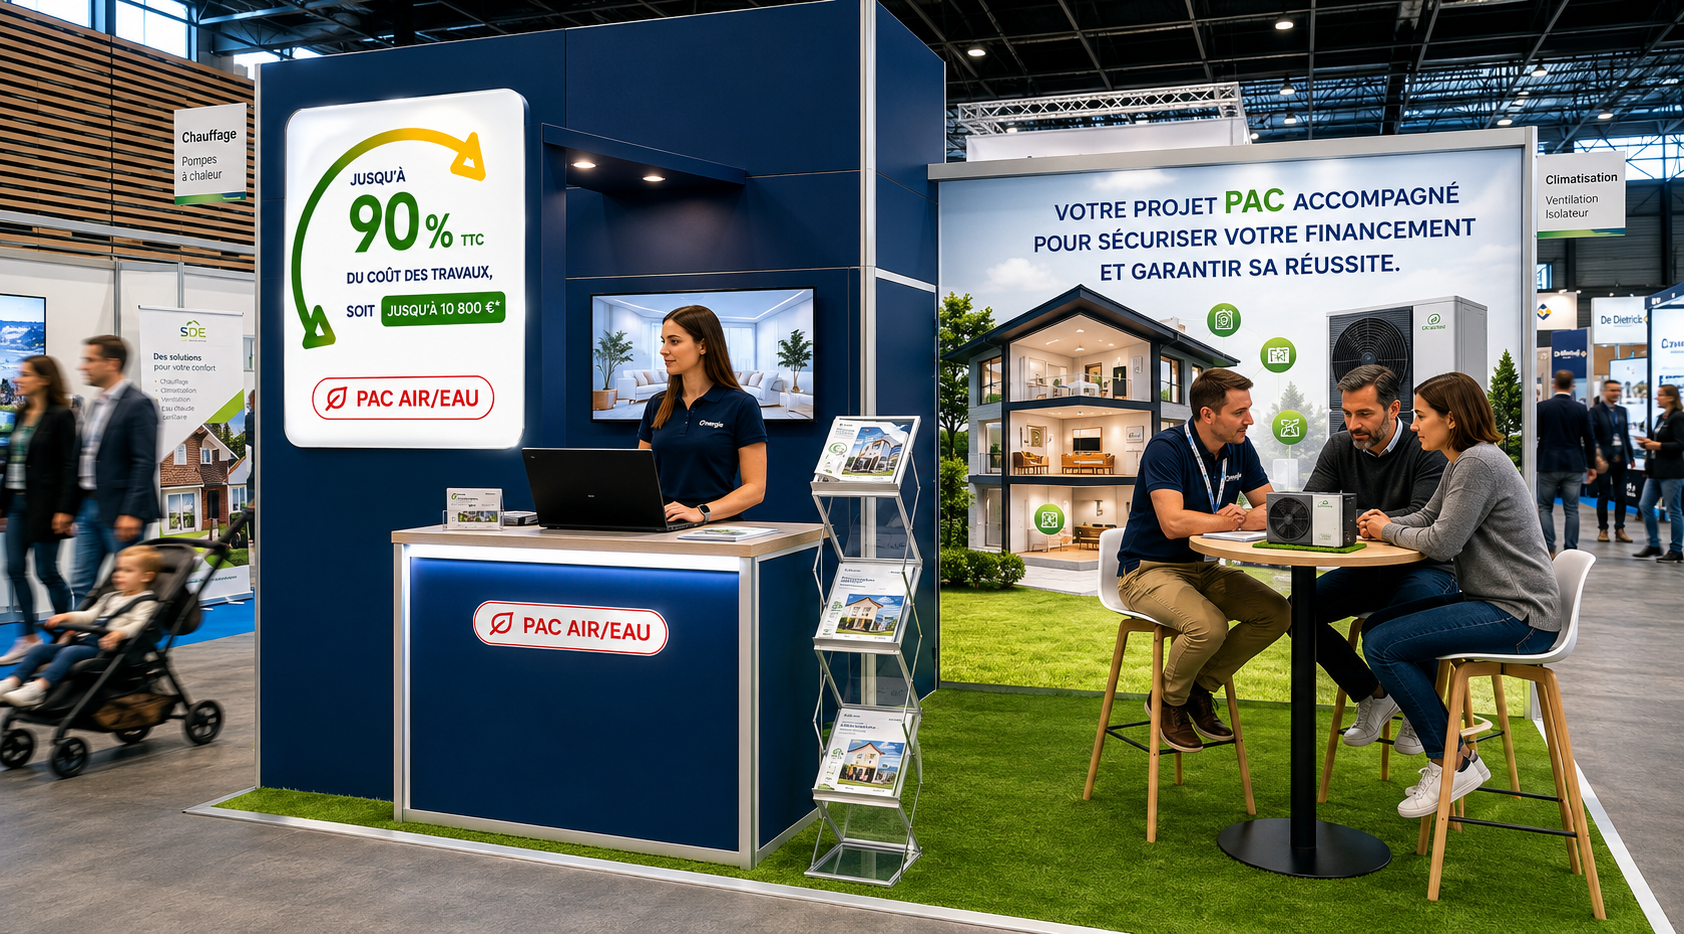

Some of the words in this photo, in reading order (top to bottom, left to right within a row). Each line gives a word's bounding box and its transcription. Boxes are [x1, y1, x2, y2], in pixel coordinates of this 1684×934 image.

[181, 129, 237, 143] Chauffage
[181, 155, 218, 167] Pompes
[181, 171, 188, 182] à
[189, 170, 223, 182] chaleur
[350, 166, 406, 186] JUSQU'À
[1545, 172, 1618, 185] Climatisation
[1054, 201, 1127, 221] VOTRE
[1134, 196, 1218, 218] PROJET
[1225, 187, 1285, 214] PAC
[1292, 181, 1460, 211] ACCOMPAGNÉ
[1545, 194, 1599, 205] Ventilation
[1545, 208, 1589, 219] Isolateur
[349, 191, 420, 254] 90
[425, 212, 454, 249] %
[460, 232, 485, 247] TTC
[1034, 234, 1092, 253] POUR
[1098, 229, 1218, 251] SÉCURISER
[1223, 225, 1298, 246] VOTRE
[1305, 217, 1477, 242] FINANCEMENT
[1100, 264, 1126, 282] ET
[1131, 260, 1242, 281] GARANTIR
[1248, 258, 1279, 277] SA
[1285, 252, 1401, 275] RÉUSSITE.
[346, 272, 364, 285] DU
[367, 266, 402, 284] COÛT
[404, 268, 429, 282] DES
[431, 265, 493, 281] TRAVAUX,
[346, 304, 376, 318] SOIT
[387, 301, 438, 317] JUSQU'À
[440, 302, 455, 315] 10
[457, 301, 482, 315] 800
[1600, 315, 1612, 325] De
[180, 327, 207, 338] SDE
[153, 352, 168, 361] Des
[169, 353, 202, 362] solutions
[153, 364, 171, 372] pour
[191, 364, 216, 372] confort
[356, 389, 394, 408] PAC
[398, 388, 479, 409] AIR/EAU
[523, 616, 562, 636] PAC
[566, 618, 651, 642] AIR/EAU
